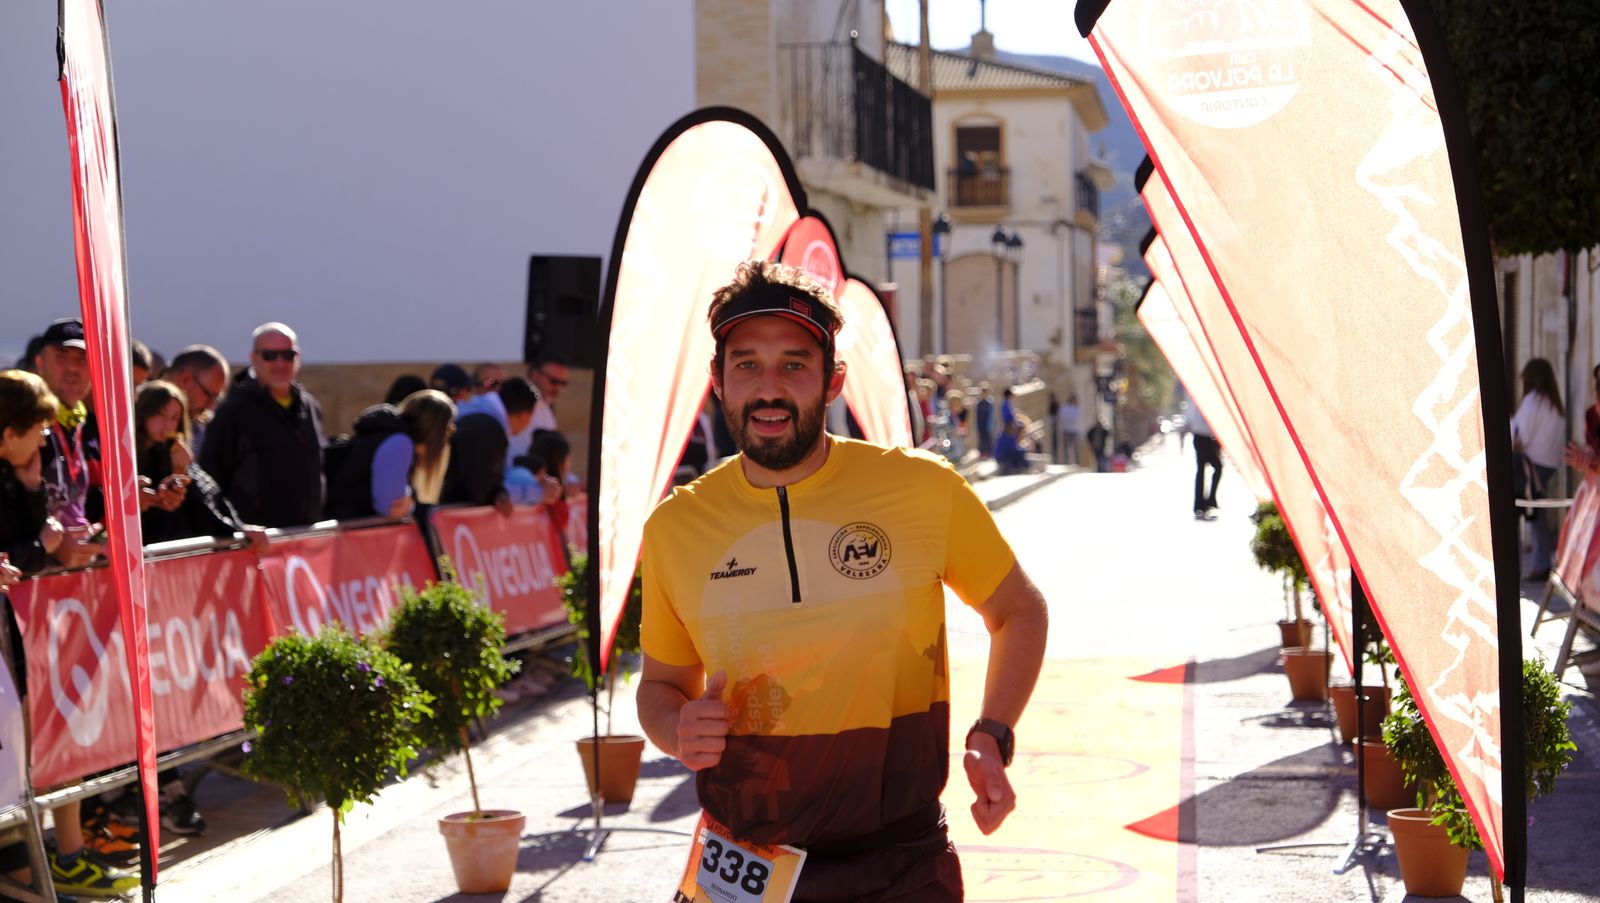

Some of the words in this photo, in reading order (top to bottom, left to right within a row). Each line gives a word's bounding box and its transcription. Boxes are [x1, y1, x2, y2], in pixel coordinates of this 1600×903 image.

[710, 567, 757, 580] TEAMERGY
[702, 838, 769, 896] 338
[710, 883, 738, 901] BERNARDO
